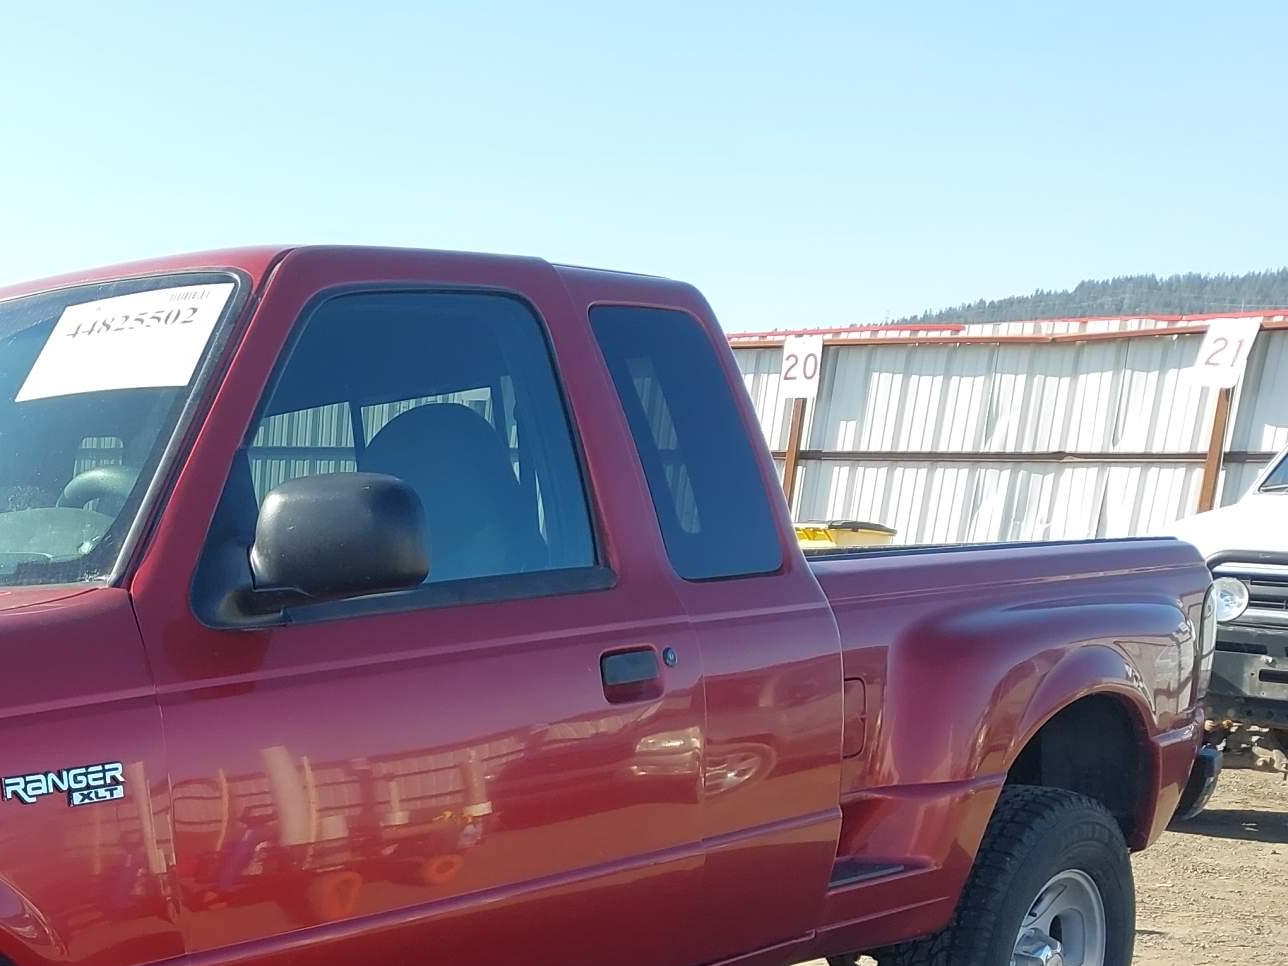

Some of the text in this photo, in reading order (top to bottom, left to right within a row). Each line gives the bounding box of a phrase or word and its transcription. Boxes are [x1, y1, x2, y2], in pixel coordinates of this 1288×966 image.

[66, 307, 198, 338] 44825502
[1204, 337, 1244, 367] 21
[783, 353, 818, 380] 20
[74, 786, 122, 804] XLT
